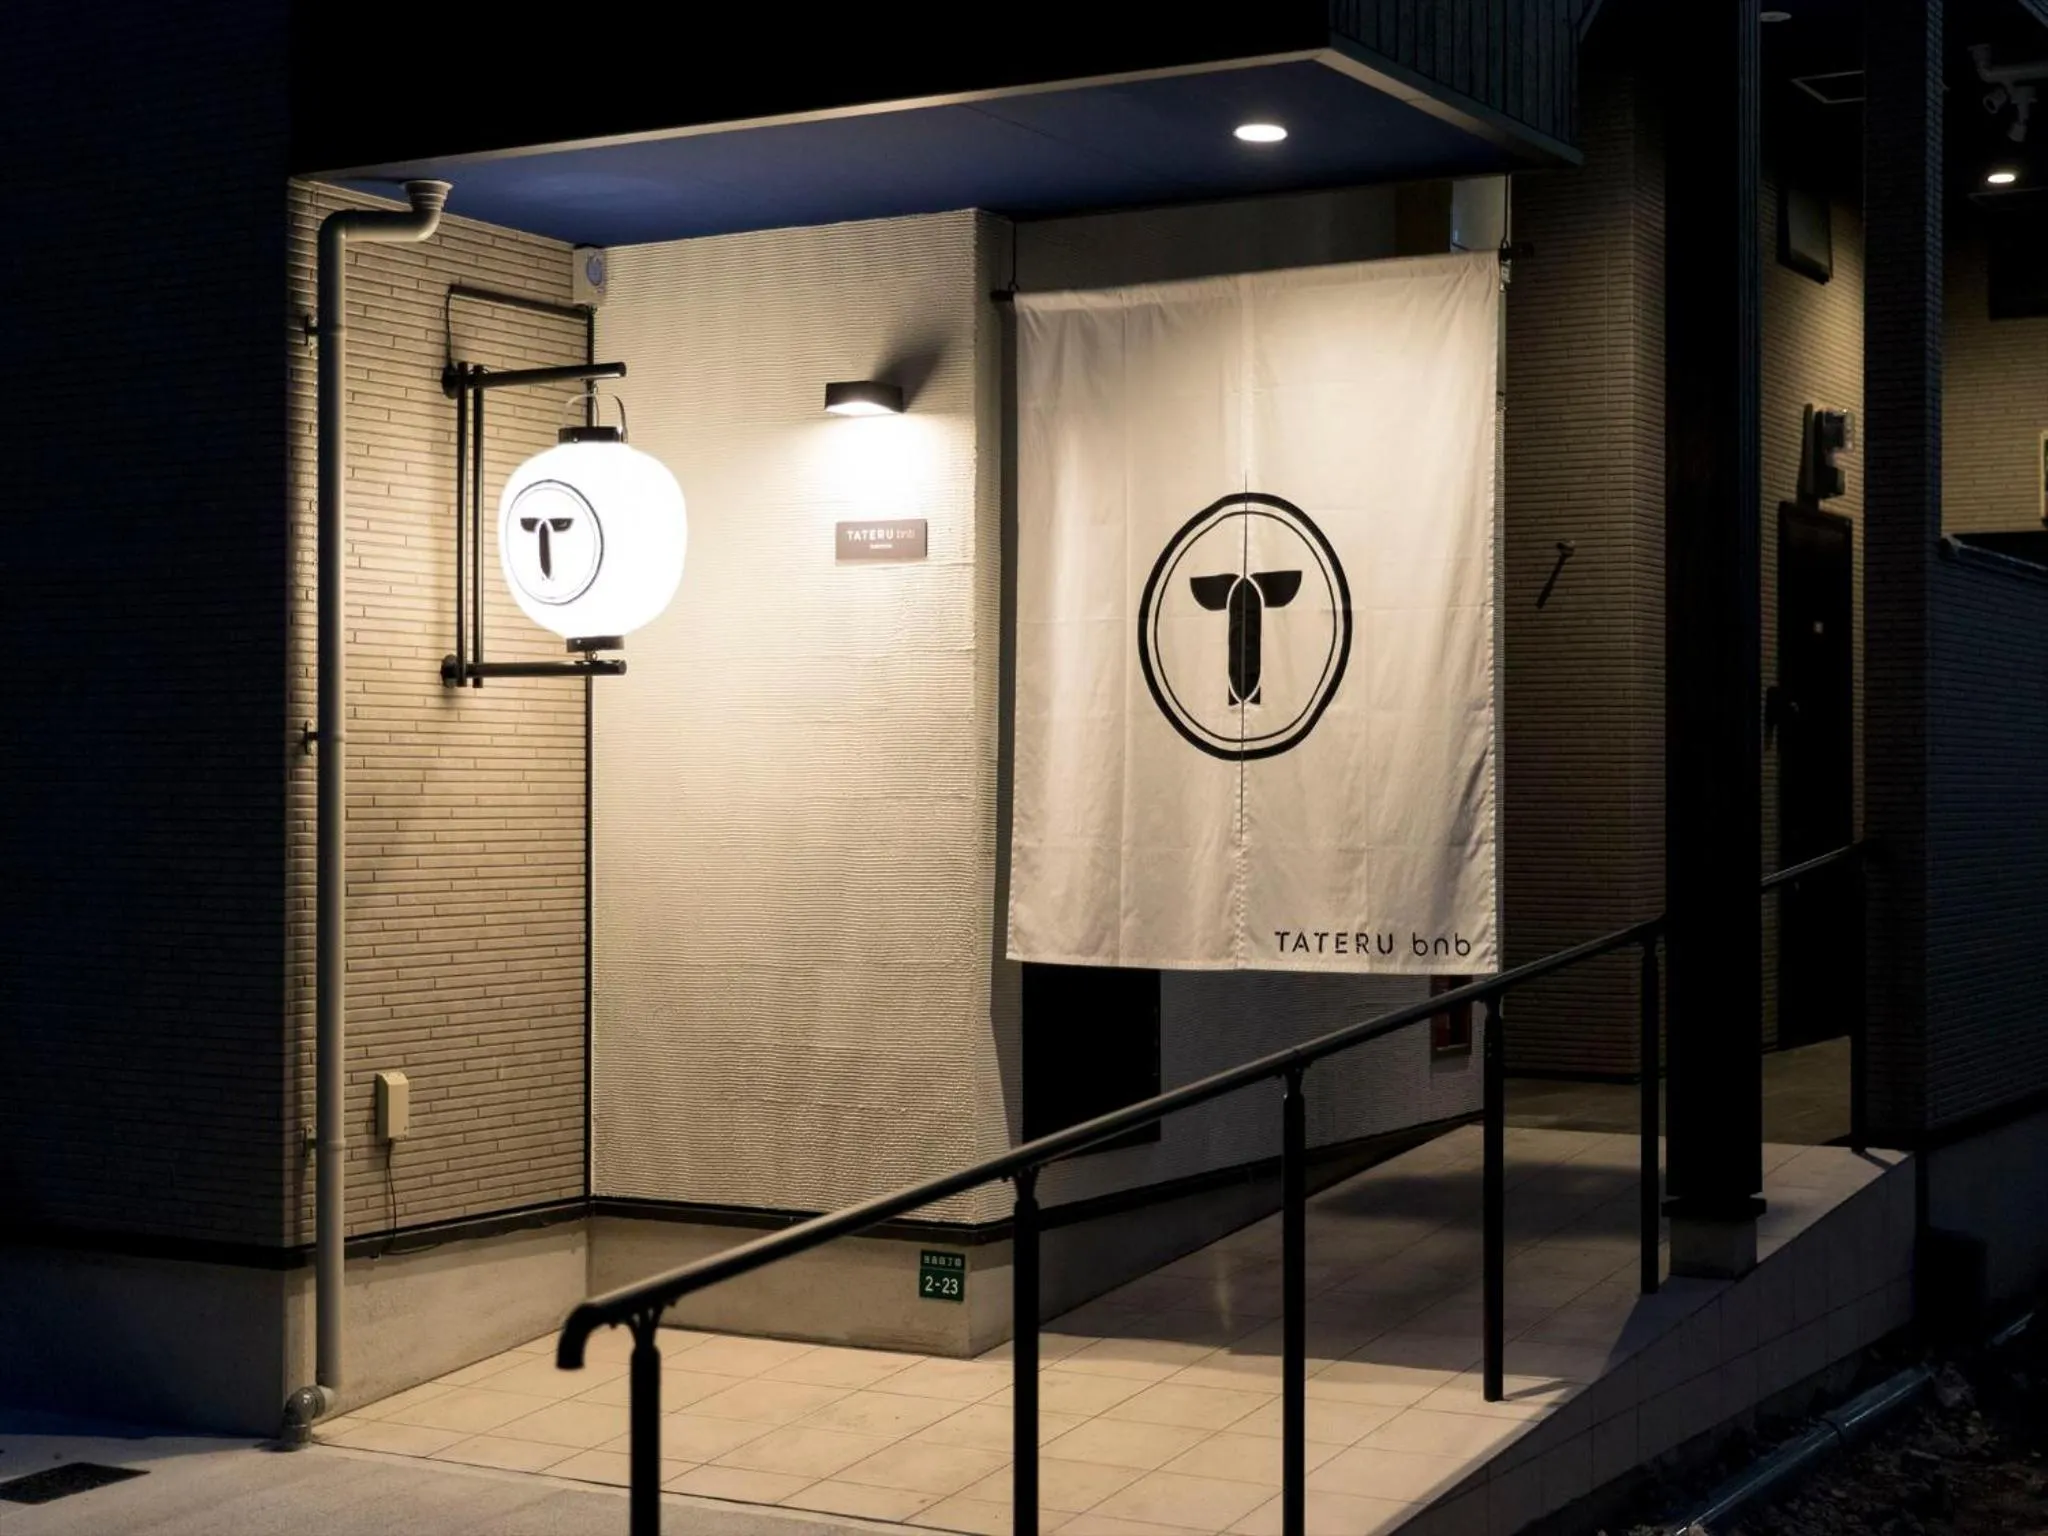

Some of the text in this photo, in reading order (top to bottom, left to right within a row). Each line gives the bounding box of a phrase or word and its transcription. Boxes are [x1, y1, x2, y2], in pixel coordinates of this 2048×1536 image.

[847, 527, 894, 542] TATERU
[1274, 931, 1471, 956] TATERU bnb
[924, 1275, 959, 1295] 2-23
